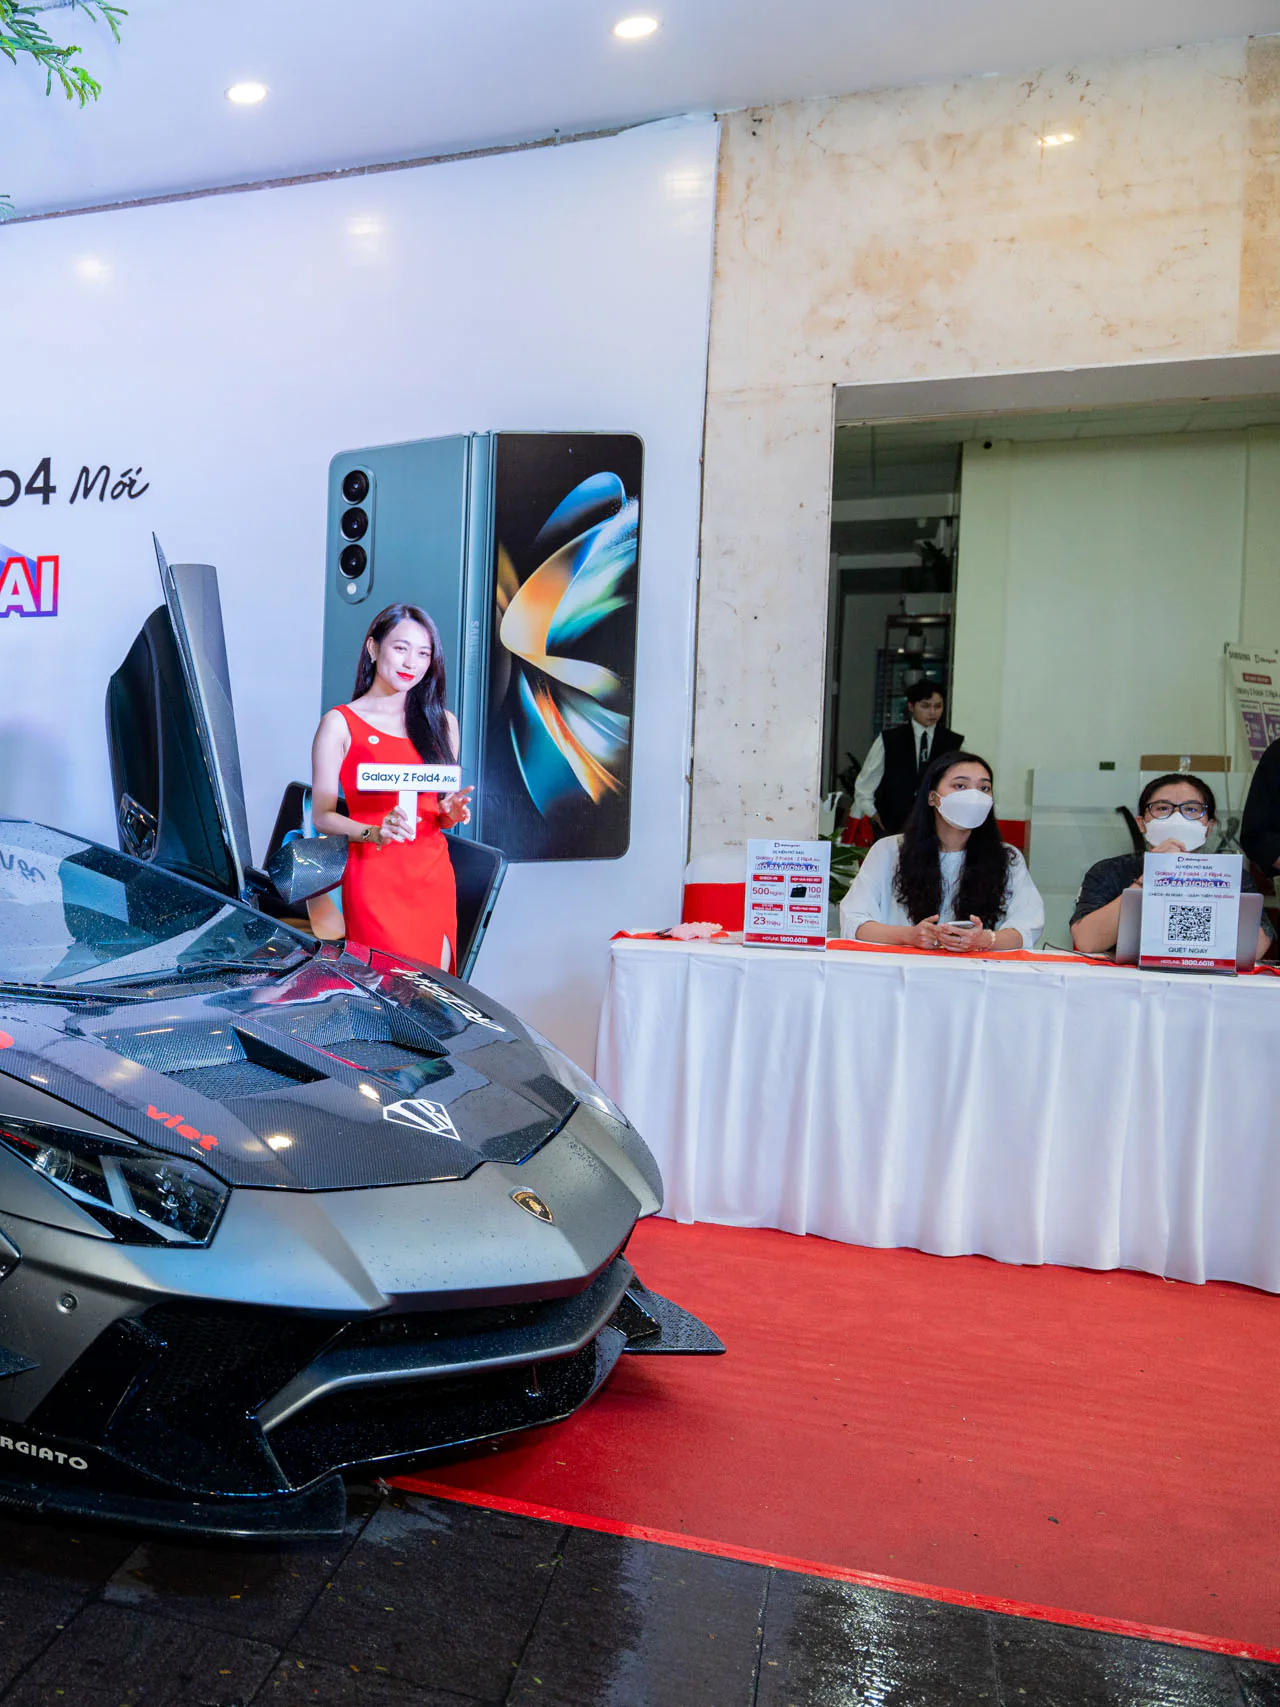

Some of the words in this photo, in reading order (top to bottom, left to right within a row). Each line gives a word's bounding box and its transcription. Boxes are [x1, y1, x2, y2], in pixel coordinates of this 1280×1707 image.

[69, 465, 150, 505] Mới
[362, 772, 400, 784] Galaxy
[403, 773, 409, 782] Z
[411, 773, 440, 782] Fold4
[752, 887, 770, 895] 500
[753, 916, 766, 925] 23
[791, 915, 804, 924] 1.5
